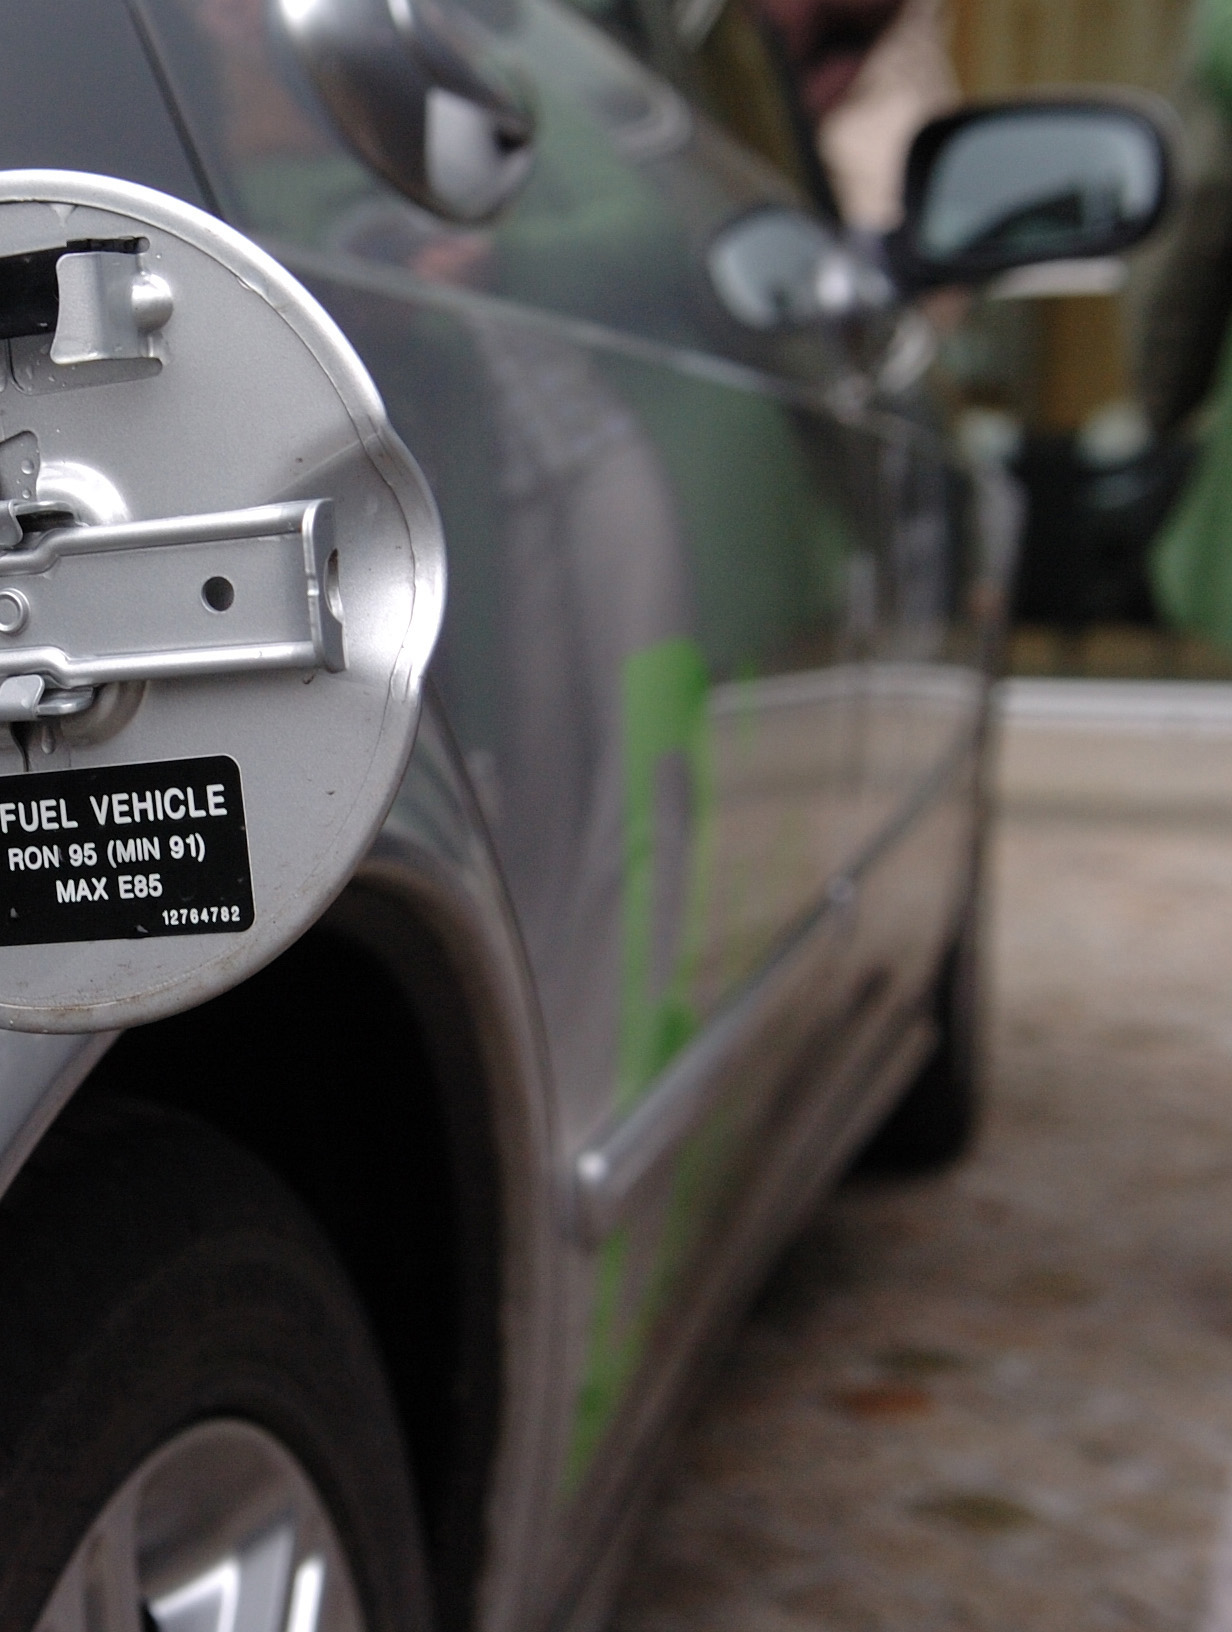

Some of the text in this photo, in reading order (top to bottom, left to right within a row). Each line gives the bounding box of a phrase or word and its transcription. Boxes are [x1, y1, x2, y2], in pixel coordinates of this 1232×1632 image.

[89, 783, 228, 826] VEHICLE
[7, 832, 206, 872] RON 95 (MIN 91)
[55, 873, 163, 904] MAX E85
